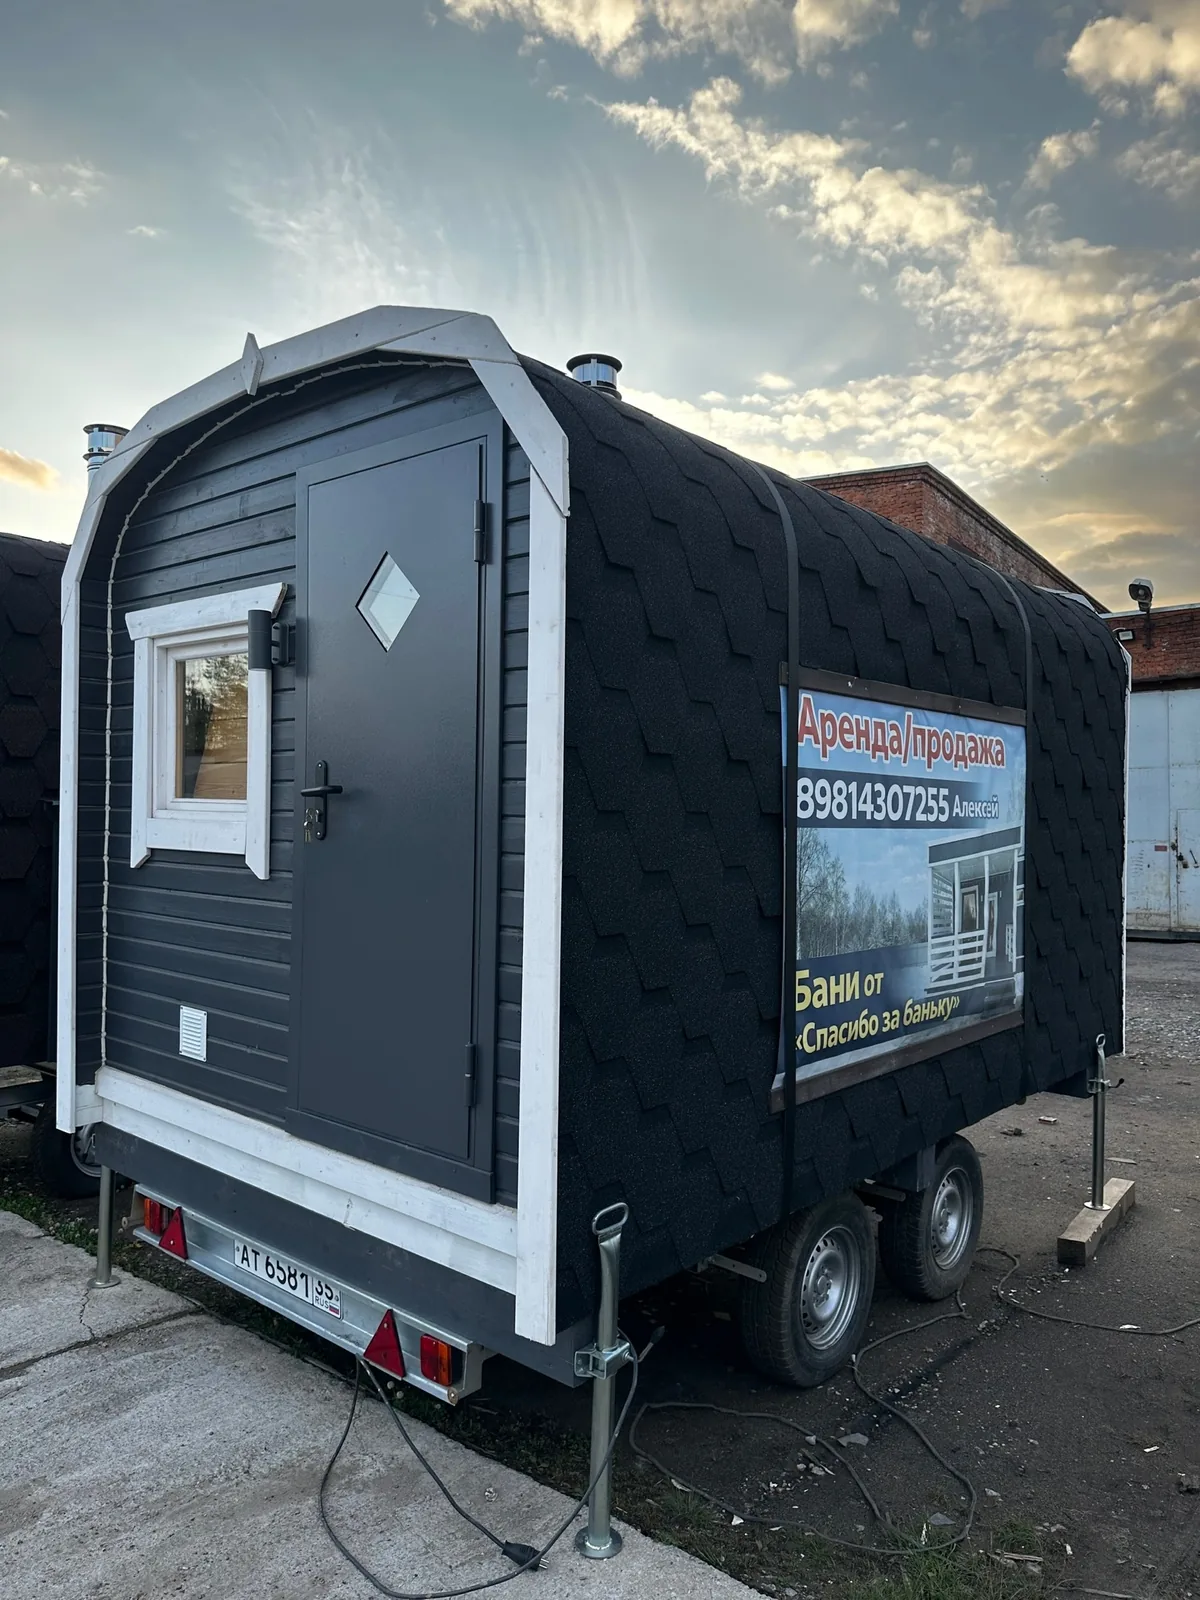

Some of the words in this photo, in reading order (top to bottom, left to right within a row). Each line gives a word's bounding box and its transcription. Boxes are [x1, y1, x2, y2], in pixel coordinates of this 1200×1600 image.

[798, 694, 1006, 770] Аренда/продажа
[797, 777, 950, 822] 89814307255
[952, 794, 999, 819] Алексей
[796, 969, 860, 1012] Бани
[864, 972, 884, 996] от
[795, 1008, 879, 1054] «Спасибо
[882, 1009, 900, 1034] за
[903, 995, 960, 1027] баньку»
[265, 1256, 309, 1298] 6581
[315, 1295, 329, 1309] RUS
